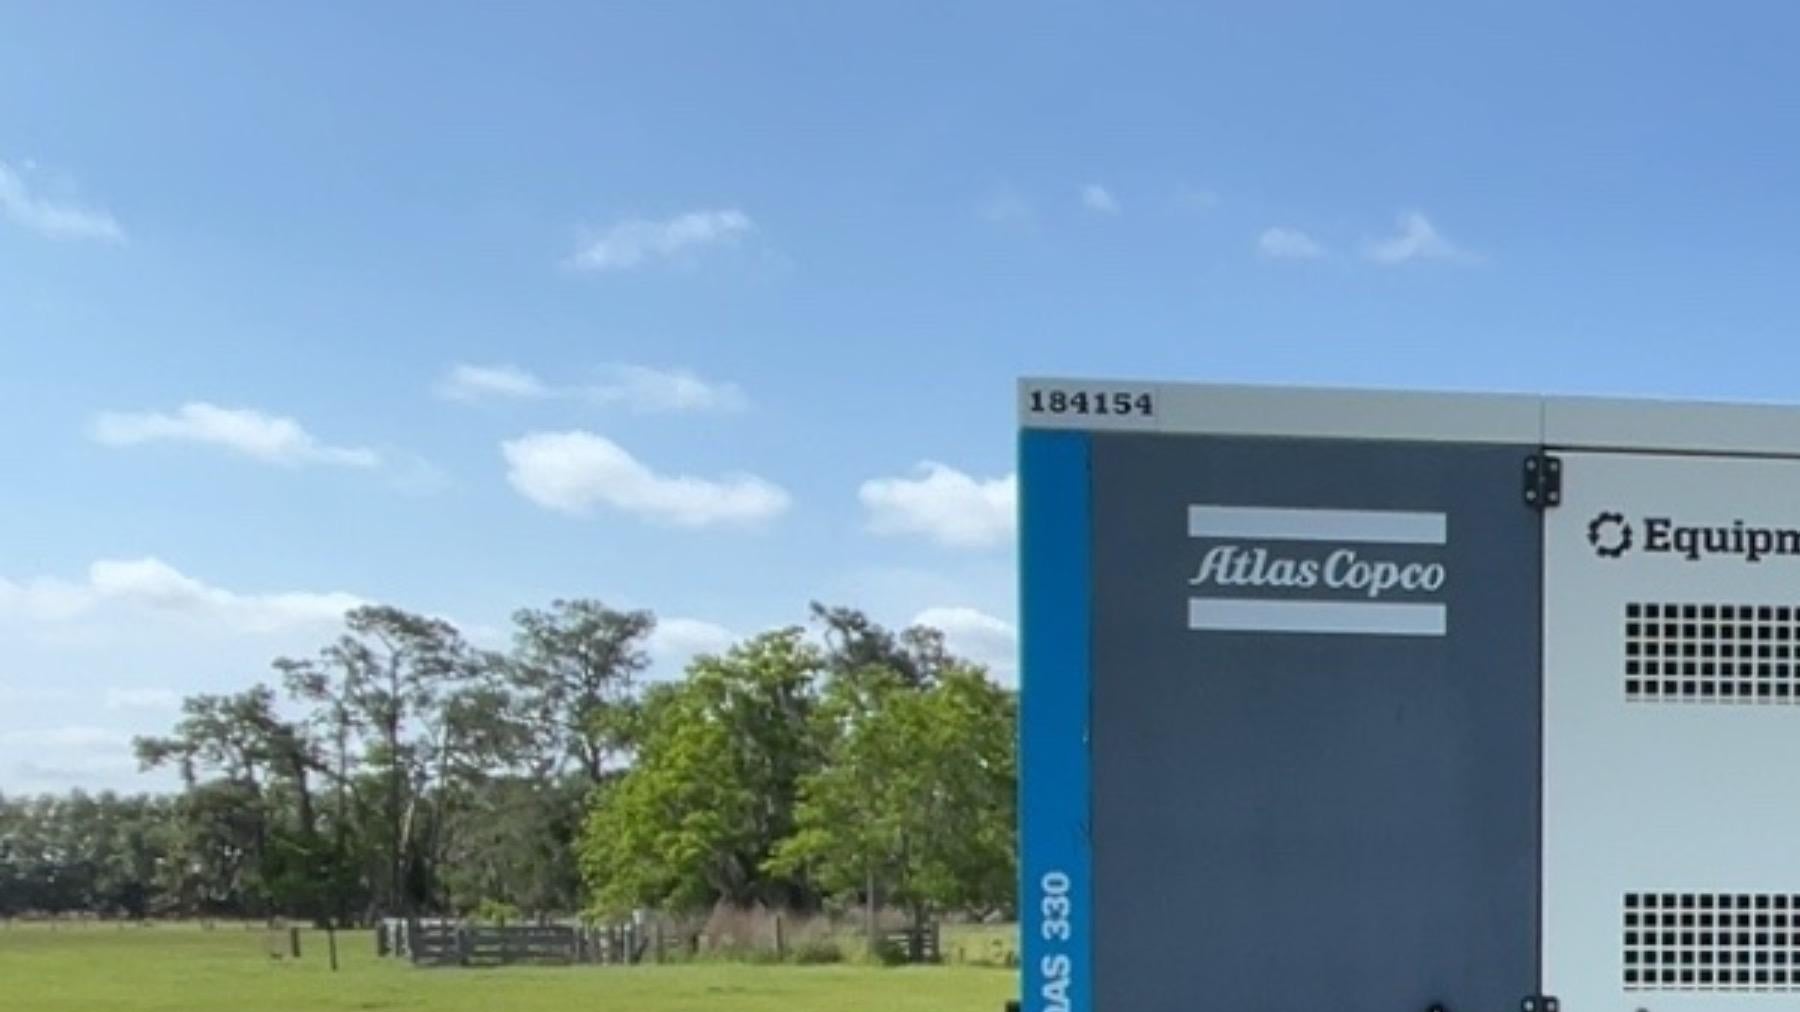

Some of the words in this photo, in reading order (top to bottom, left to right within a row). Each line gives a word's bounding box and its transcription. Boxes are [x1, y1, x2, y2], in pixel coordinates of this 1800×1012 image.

[1030, 390, 1153, 417] 184154
[1188, 545, 1318, 590] Atlas
[1323, 548, 1446, 597] Copco
[1040, 870, 1072, 941] 330
